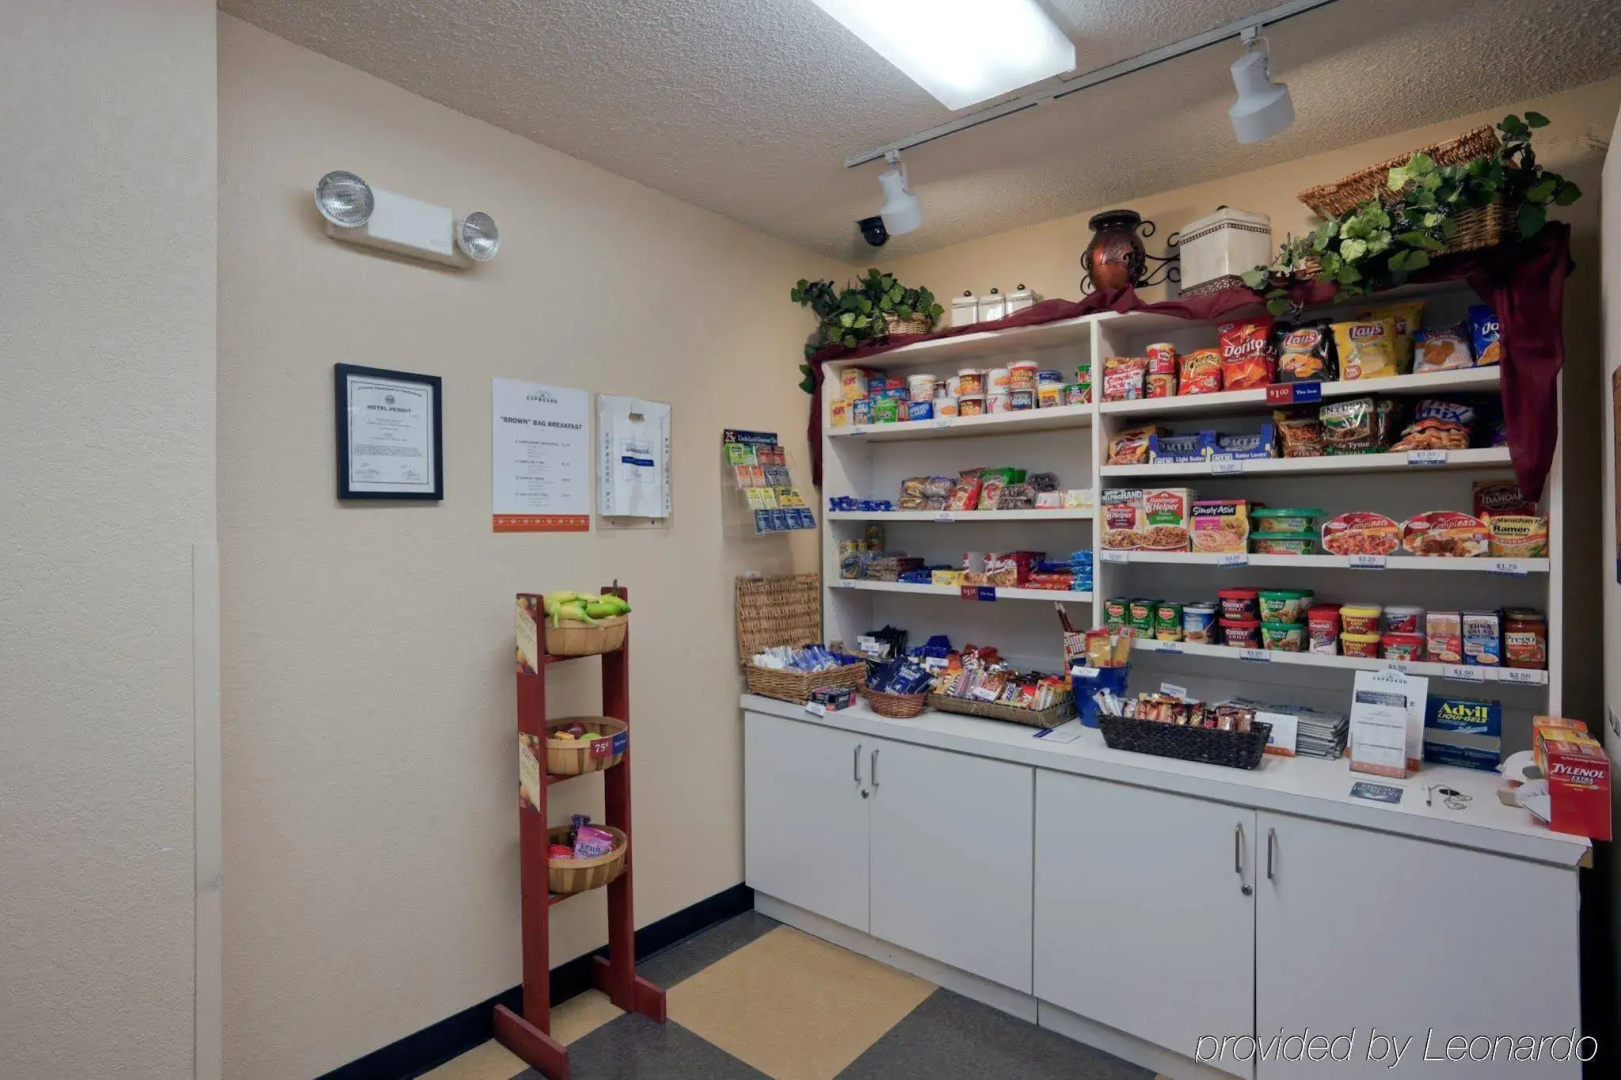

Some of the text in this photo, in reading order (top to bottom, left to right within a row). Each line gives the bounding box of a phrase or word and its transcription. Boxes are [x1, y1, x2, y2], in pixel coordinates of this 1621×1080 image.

[367, 404, 388, 412] HOTEL
[500, 416, 583, 430] "BROWN" BAG BREAKFAST
[1152, 503, 1178, 512] Helper
[1193, 506, 1235, 516] Simply Asia
[1505, 635, 1535, 645] Prego
[1437, 702, 1488, 718] Advil
[1437, 713, 1487, 724] LIQUI-GELS
[1553, 763, 1604, 779] TYLENOL
